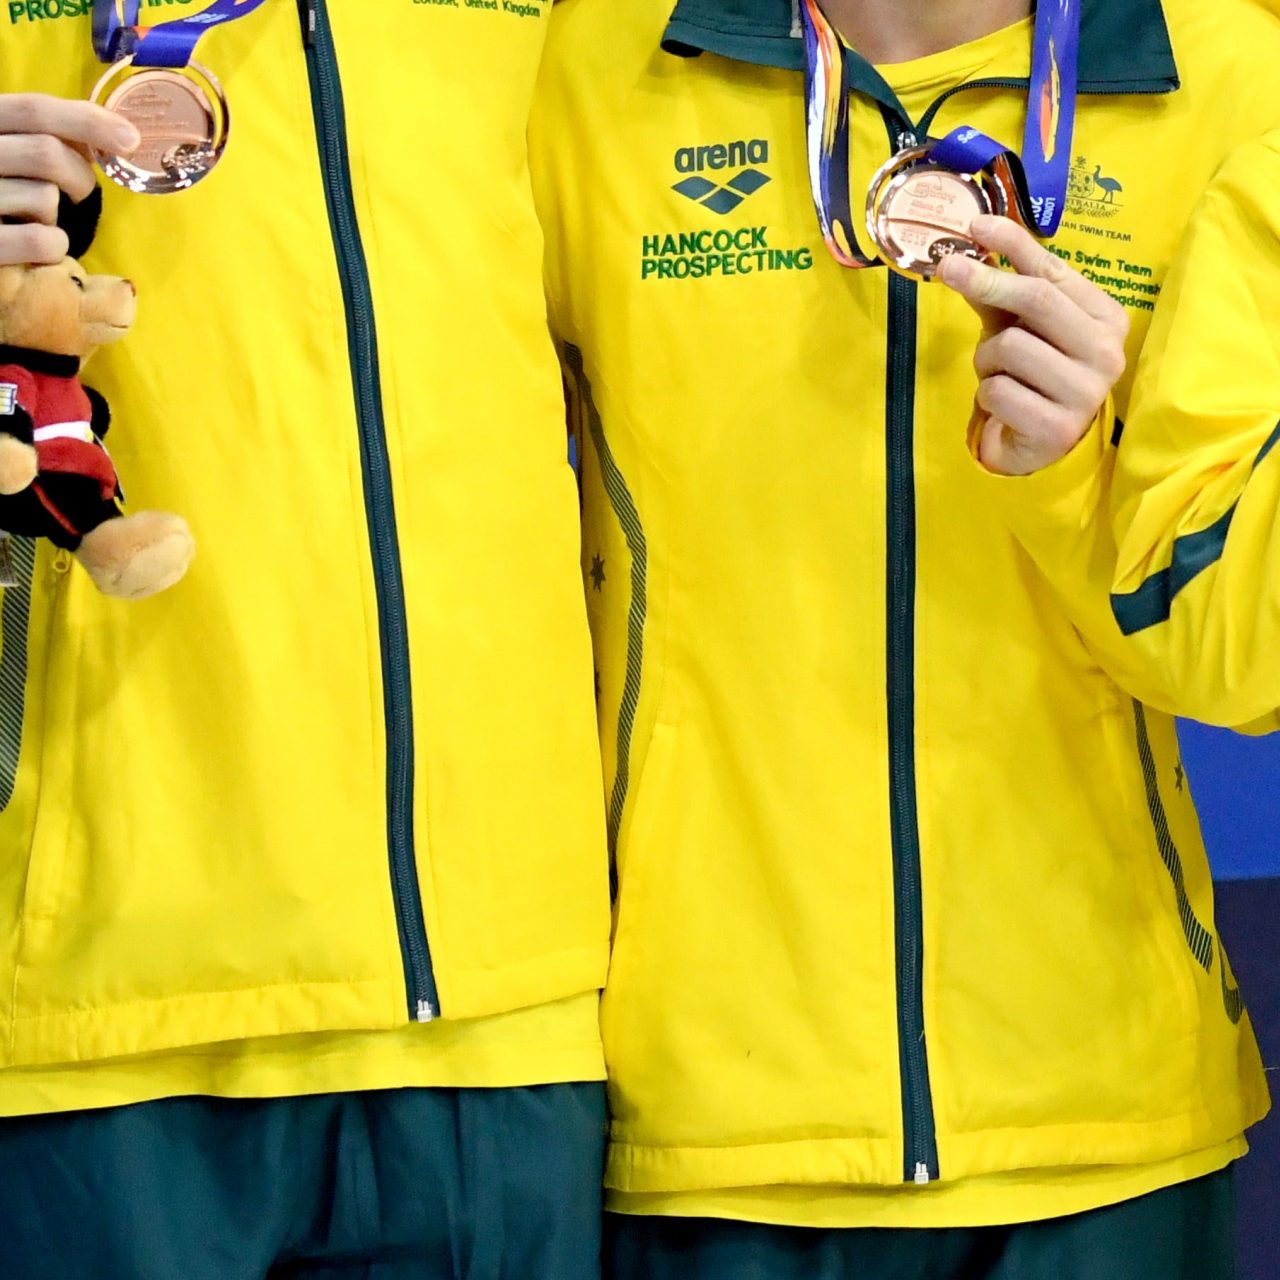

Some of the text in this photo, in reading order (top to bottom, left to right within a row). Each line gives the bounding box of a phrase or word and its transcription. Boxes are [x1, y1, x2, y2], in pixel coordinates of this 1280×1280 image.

[502, 0, 540, 18] Kingdom
[674, 139, 769, 173] arena
[642, 226, 768, 257] HANCOCK
[1079, 224, 1103, 237] SWIM
[1105, 231, 1132, 242] TEAM
[641, 248, 813, 280] PROSPECTING
[1075, 250, 1111, 269] Swim
[1117, 259, 1152, 278] Team
